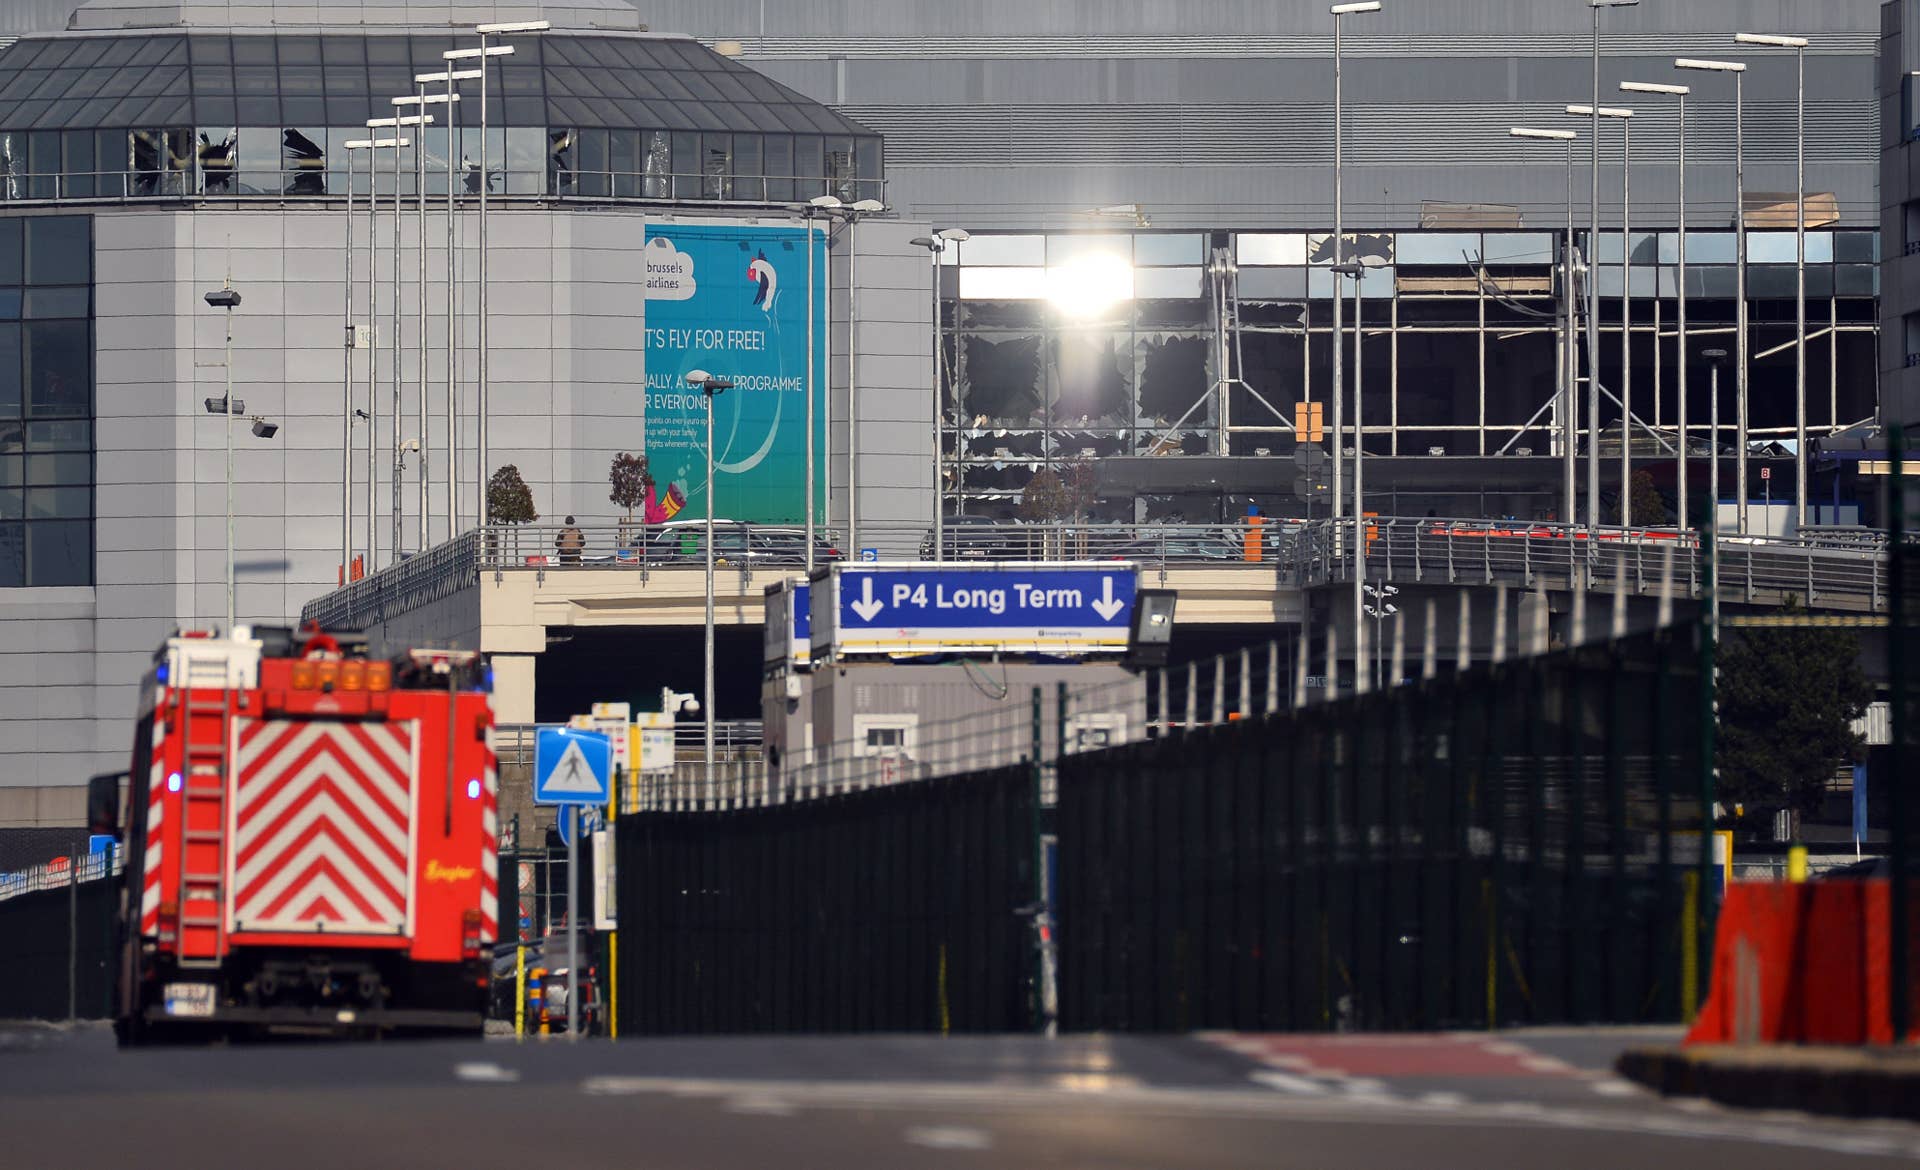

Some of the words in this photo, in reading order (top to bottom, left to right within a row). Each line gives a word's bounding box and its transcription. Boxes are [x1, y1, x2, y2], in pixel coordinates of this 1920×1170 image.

[646, 260, 683, 273] brussels
[646, 277, 679, 288] airlines
[669, 329, 692, 349] FLY
[695, 330, 724, 350] FOR
[675, 374, 685, 389] A
[733, 375, 803, 392] PROGRAMME
[655, 394, 709, 410] EVERYONE
[664, 417, 672, 425] on
[892, 583, 928, 608] P4
[936, 583, 1006, 615] Long
[1013, 583, 1082, 608] Term
